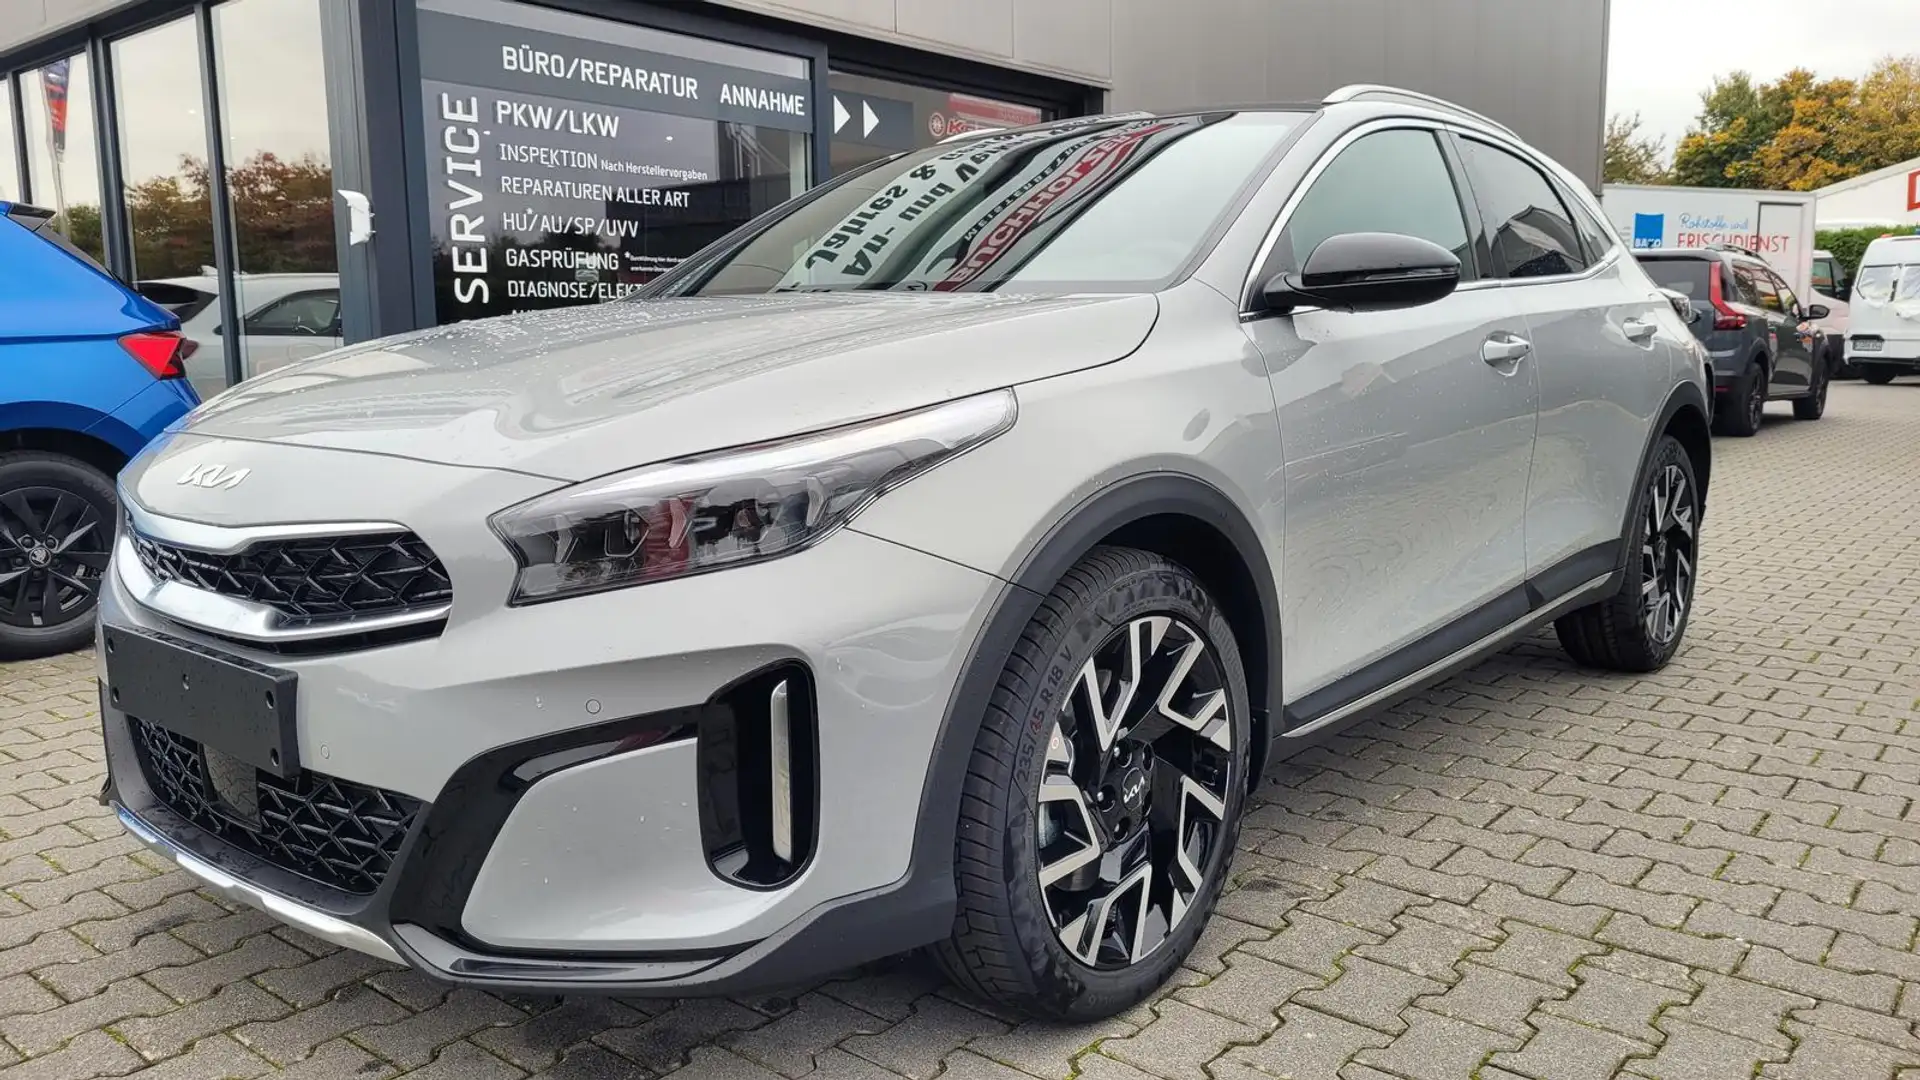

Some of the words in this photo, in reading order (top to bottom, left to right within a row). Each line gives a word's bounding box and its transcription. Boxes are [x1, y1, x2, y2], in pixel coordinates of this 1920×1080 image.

[502, 45, 698, 100] BÜRO/REPARATUR
[720, 83, 805, 116] ANNAHME
[497, 100, 620, 138] PKW/LKW
[499, 144, 598, 170] INSPEKTION
[601, 159, 625, 173] Nach
[626, 163, 708, 181] Herstellervorgaben
[442, 92, 490, 304] SERVICE
[501, 177, 612, 201] REPARATUREN
[616, 187, 661, 206] ALLER
[664, 191, 690, 208] ART
[506, 248, 619, 271] GASPRÜFUNG
